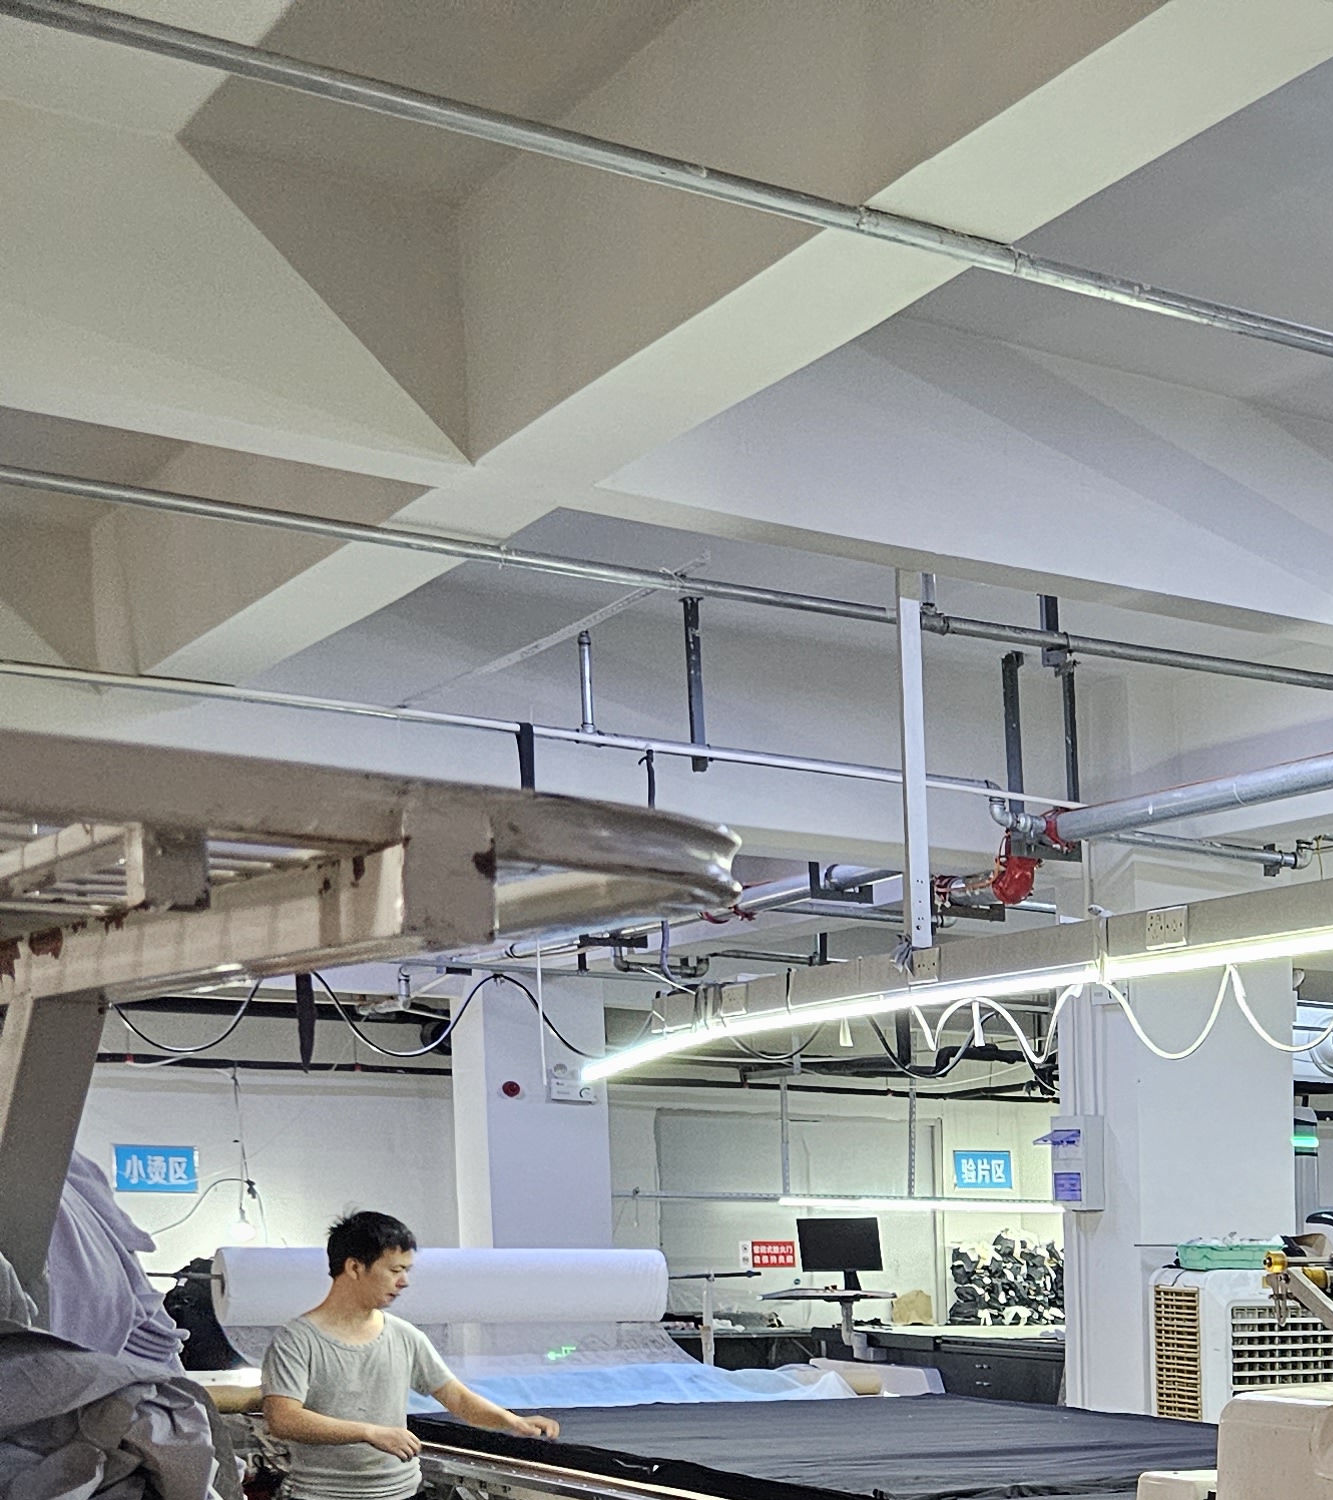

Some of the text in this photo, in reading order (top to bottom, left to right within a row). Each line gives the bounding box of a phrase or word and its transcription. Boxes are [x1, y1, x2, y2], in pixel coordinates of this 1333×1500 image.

[125, 1154, 188, 1185] 小烫区
[961, 1158, 1006, 1184] 验片区
